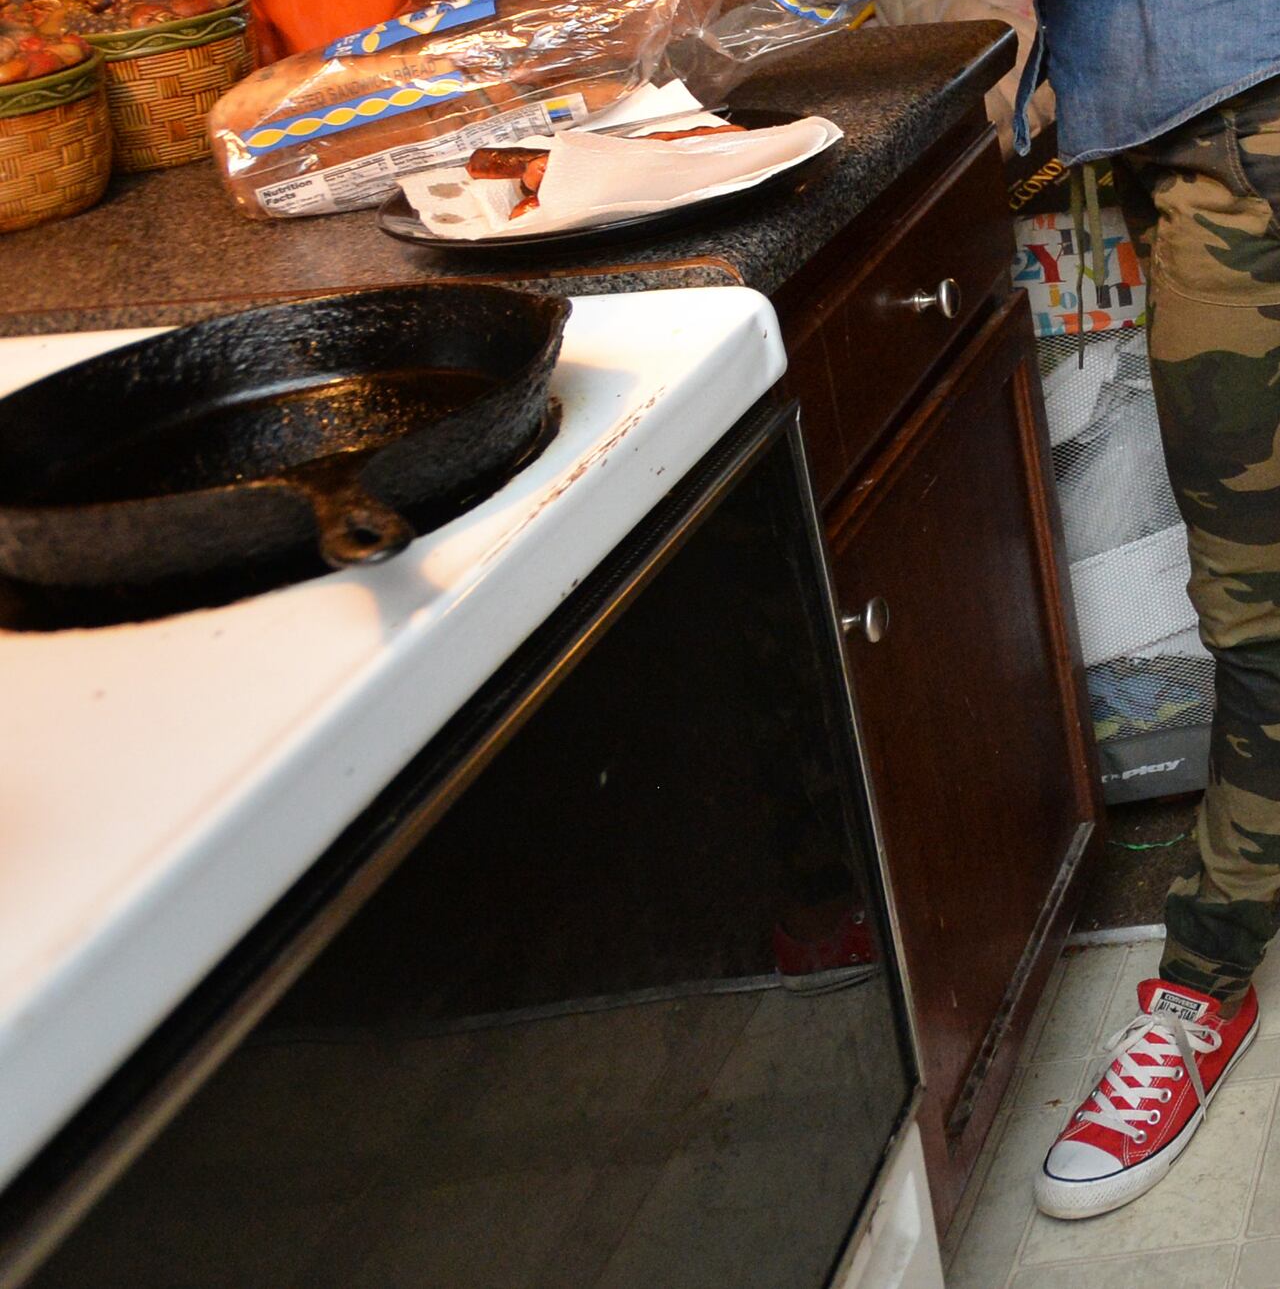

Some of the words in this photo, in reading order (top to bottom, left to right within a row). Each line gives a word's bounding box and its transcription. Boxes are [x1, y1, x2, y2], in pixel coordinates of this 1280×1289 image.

[393, 59, 438, 83] BREAD
[262, 179, 313, 198] Nutrition
[265, 192, 297, 206] Facts
